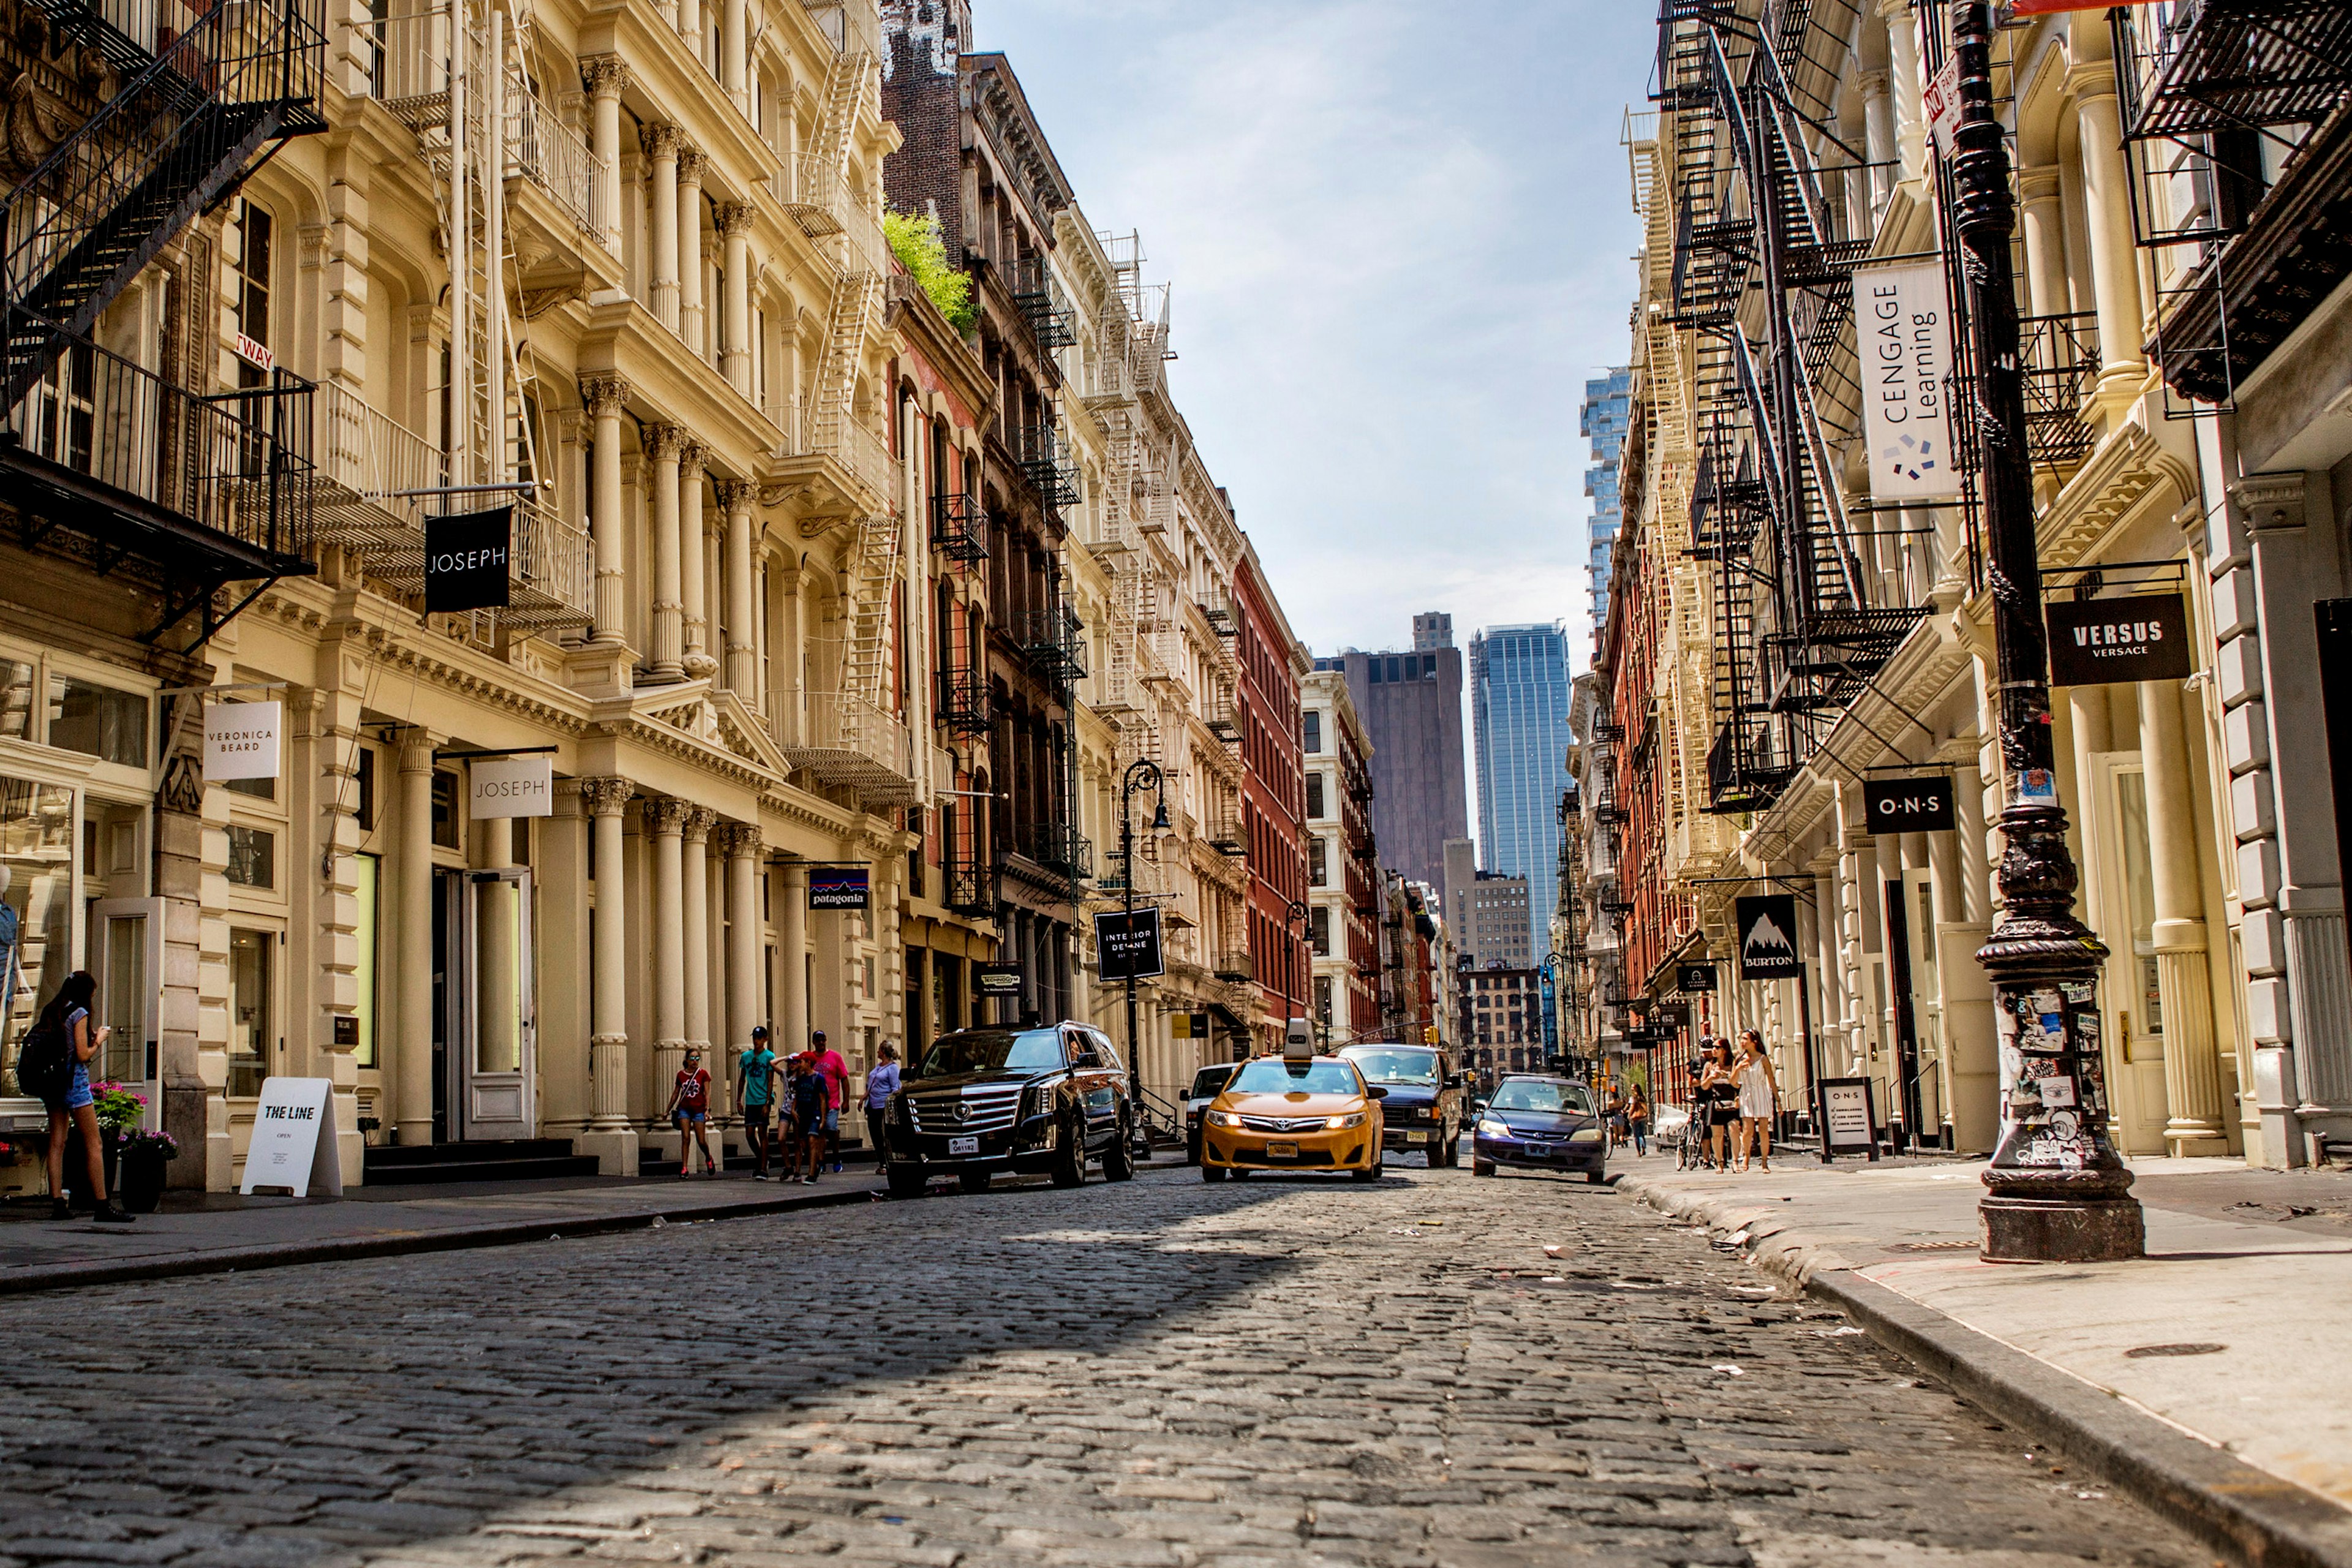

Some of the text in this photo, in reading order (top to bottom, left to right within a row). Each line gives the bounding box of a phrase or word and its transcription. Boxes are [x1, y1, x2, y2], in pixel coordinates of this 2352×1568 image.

[1926, 87, 1943, 118] NO
[1874, 285, 1908, 423] CENGAGE
[1910, 312, 1939, 419] Learning
[429, 547, 505, 573] JOSEPH
[2073, 621, 2163, 646] VERSUS
[2093, 646, 2148, 657] VERSACE
[209, 731, 272, 741] VERONICA
[221, 742, 259, 752] BEARD
[476, 780, 544, 797] JOSEPH
[813, 894, 864, 904] patagonia
[1112, 941, 1147, 951] DENE
[1746, 957, 1793, 967] BURTON
[266, 1106, 314, 1120] THE LINE
